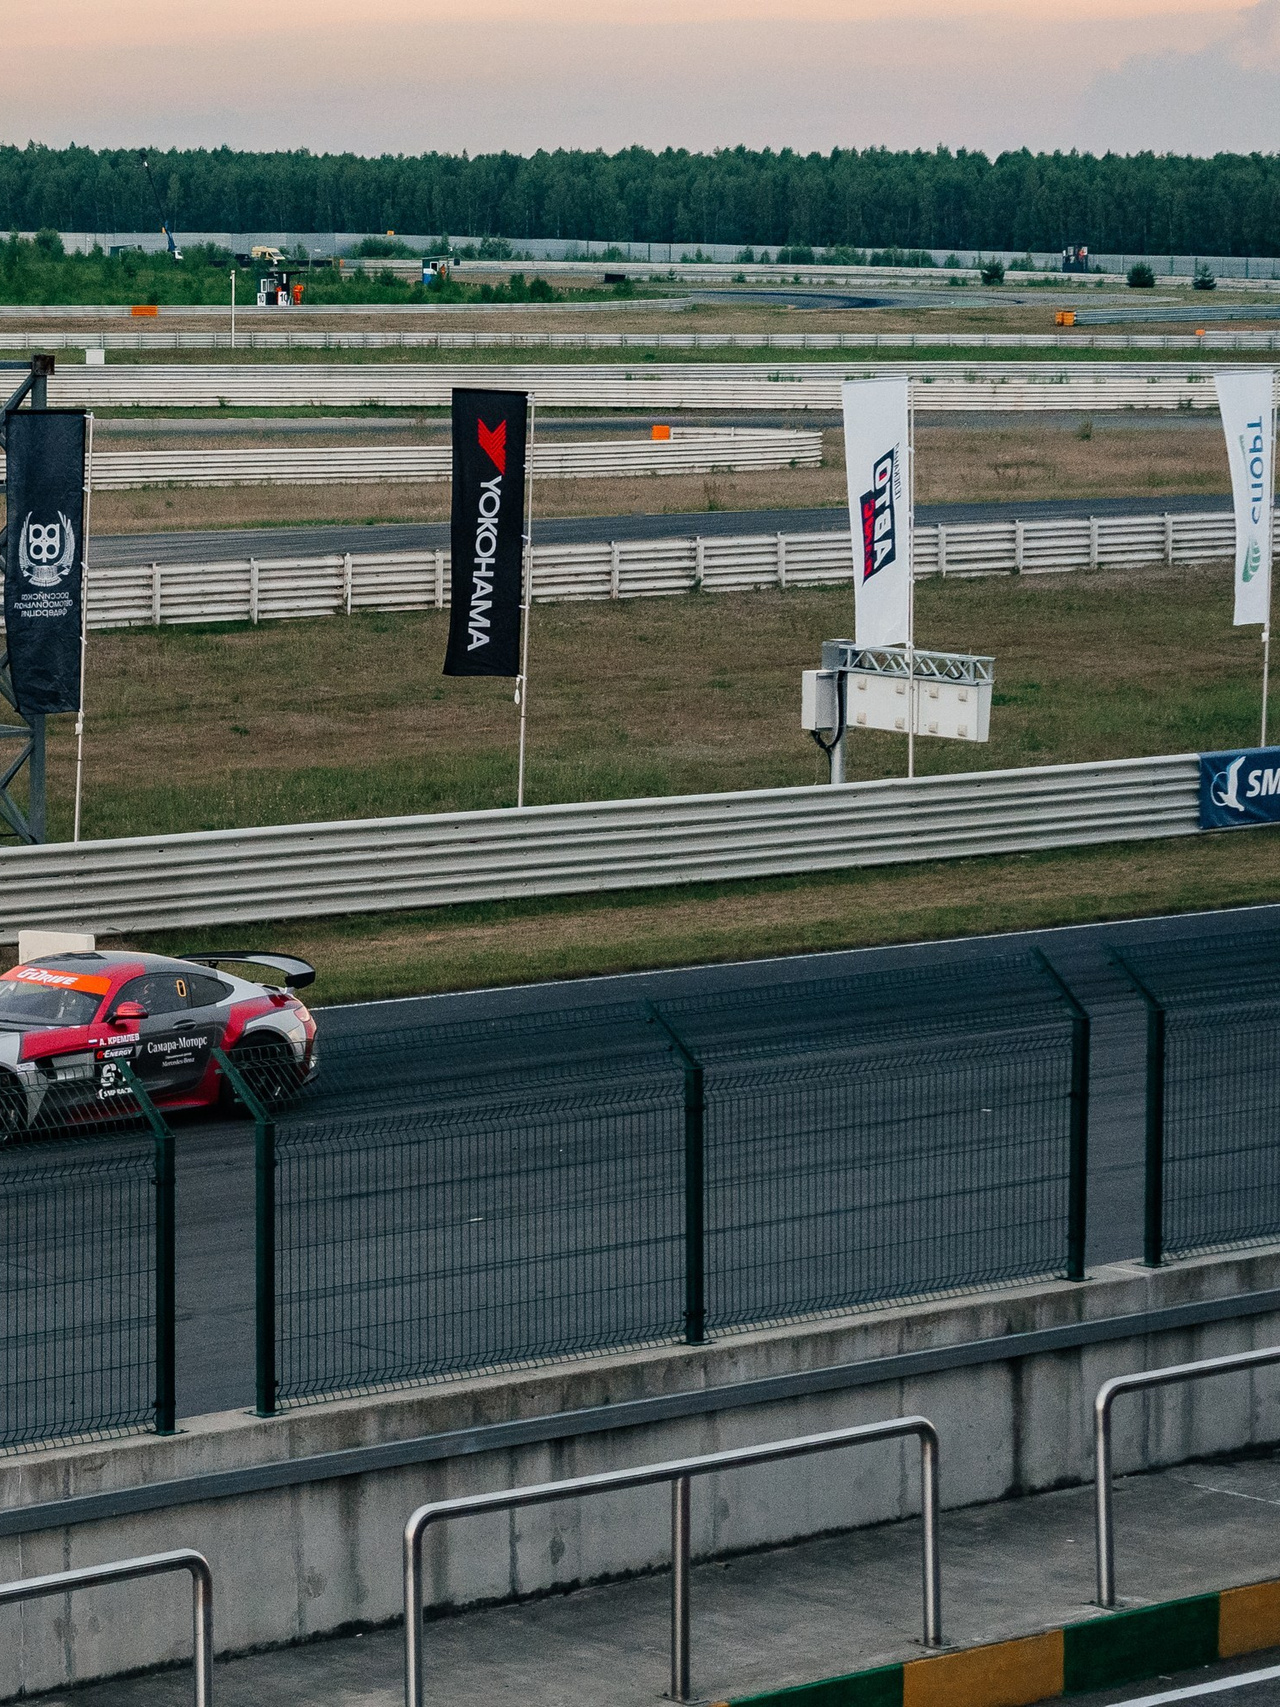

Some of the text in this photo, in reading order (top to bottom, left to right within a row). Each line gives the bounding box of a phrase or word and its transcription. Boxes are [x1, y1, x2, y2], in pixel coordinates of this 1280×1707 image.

[467, 475, 503, 652] YOKOHAMA
[96, 1048, 133, 1059] G-ENERGY
[147, 1036, 208, 1054] Самара-Моторс
